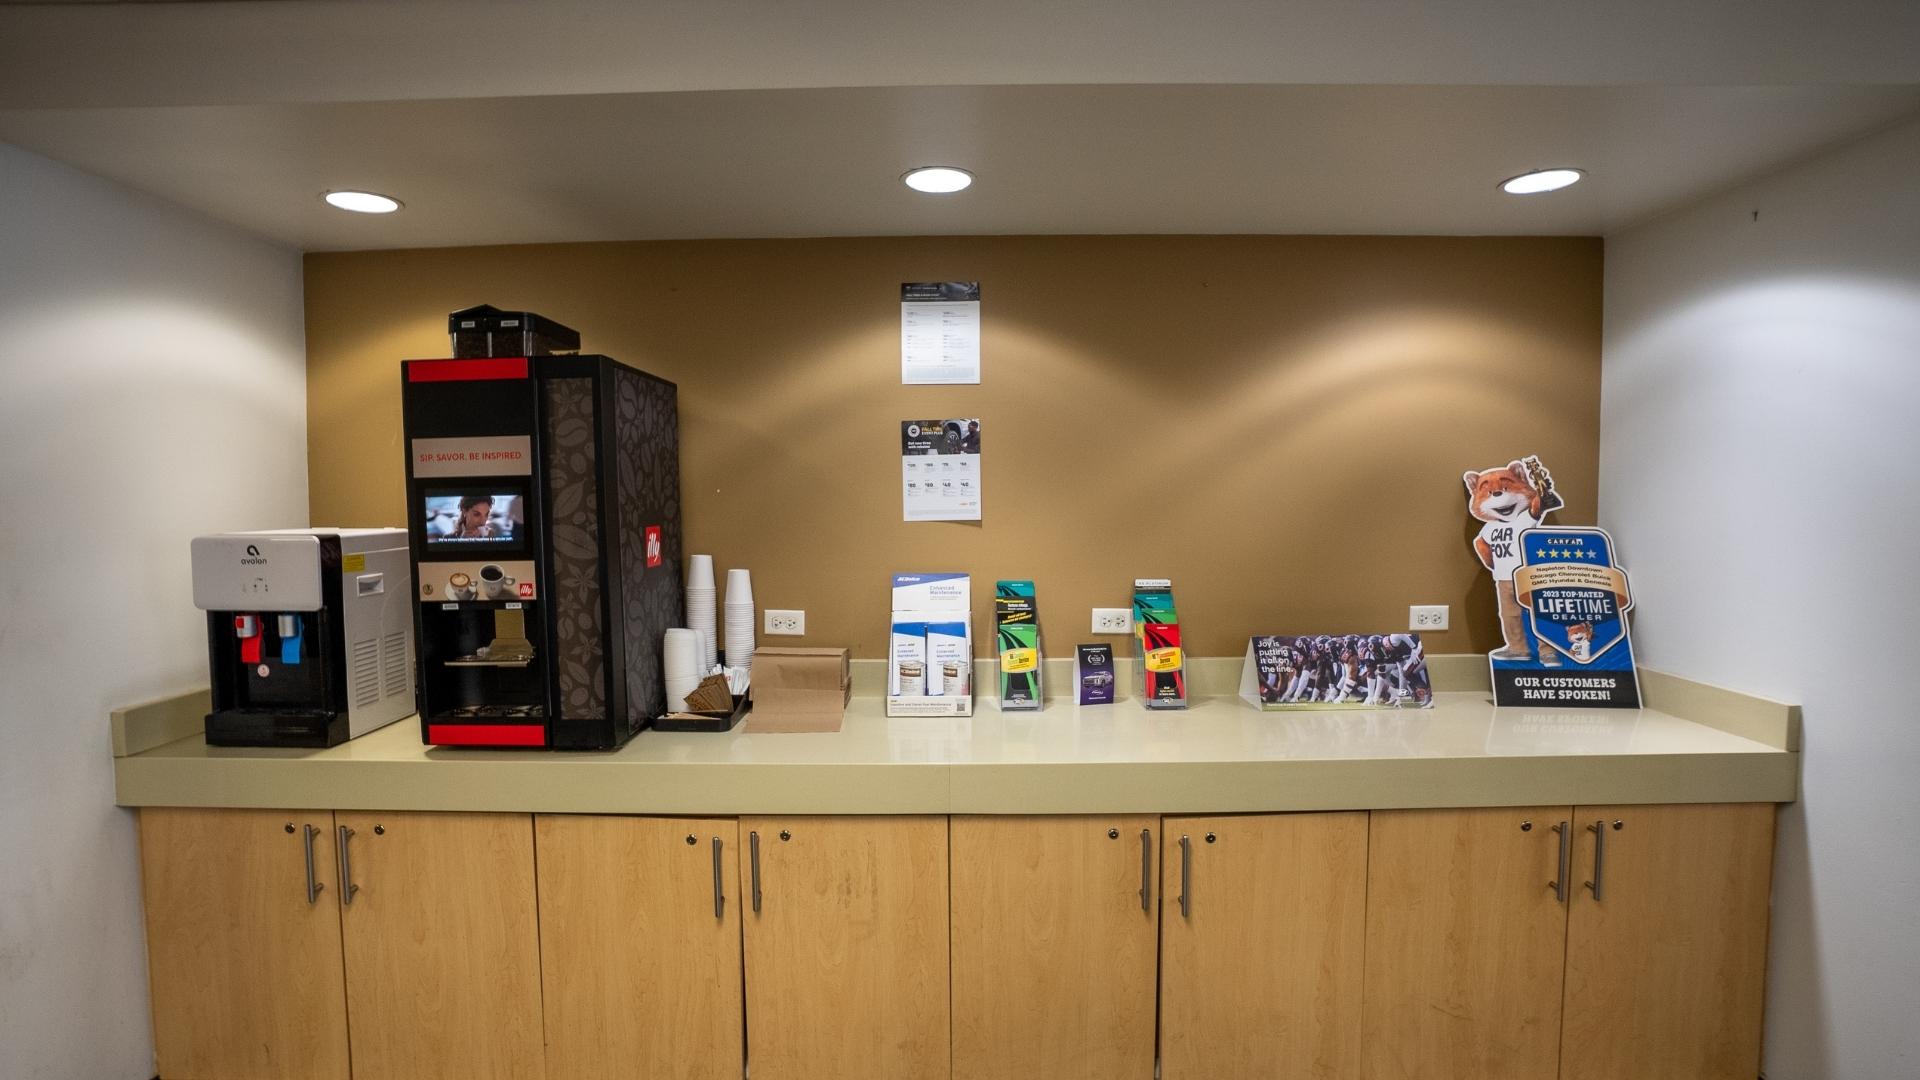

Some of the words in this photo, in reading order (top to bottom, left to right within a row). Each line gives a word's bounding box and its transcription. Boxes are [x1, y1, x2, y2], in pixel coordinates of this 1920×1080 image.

[420, 454, 434, 463] SIP.
[469, 452, 480, 461] BE
[1490, 527, 1513, 542] CAR
[647, 532, 661, 562] illy
[1490, 542, 1514, 558] FOX
[1536, 565, 1566, 573] Napleton
[1567, 565, 1603, 574] Downtown
[1530, 572, 1557, 580] Chicago
[1592, 573, 1611, 581] Buick
[1584, 579, 1612, 587] Genesis
[520, 585, 532, 595] illy
[1542, 590, 1560, 598] 2023
[1560, 590, 1604, 598] TOP-RATED
[1538, 598, 1613, 614] LIFETIME
[1552, 613, 1602, 621] DEALER
[1257, 640, 1272, 649] Joy
[1258, 647, 1289, 658] putting
[1260, 655, 1266, 664] it
[1267, 655, 1277, 664] all
[1278, 657, 1290, 665] on
[1261, 665, 1275, 673] the
[1276, 665, 1294, 673] line.
[1514, 677, 1541, 687] OUR
[1542, 677, 1616, 688] CUSTOMERS
[1523, 689, 1556, 699] HAVE
[1558, 689, 1611, 700] SPOKEN!
